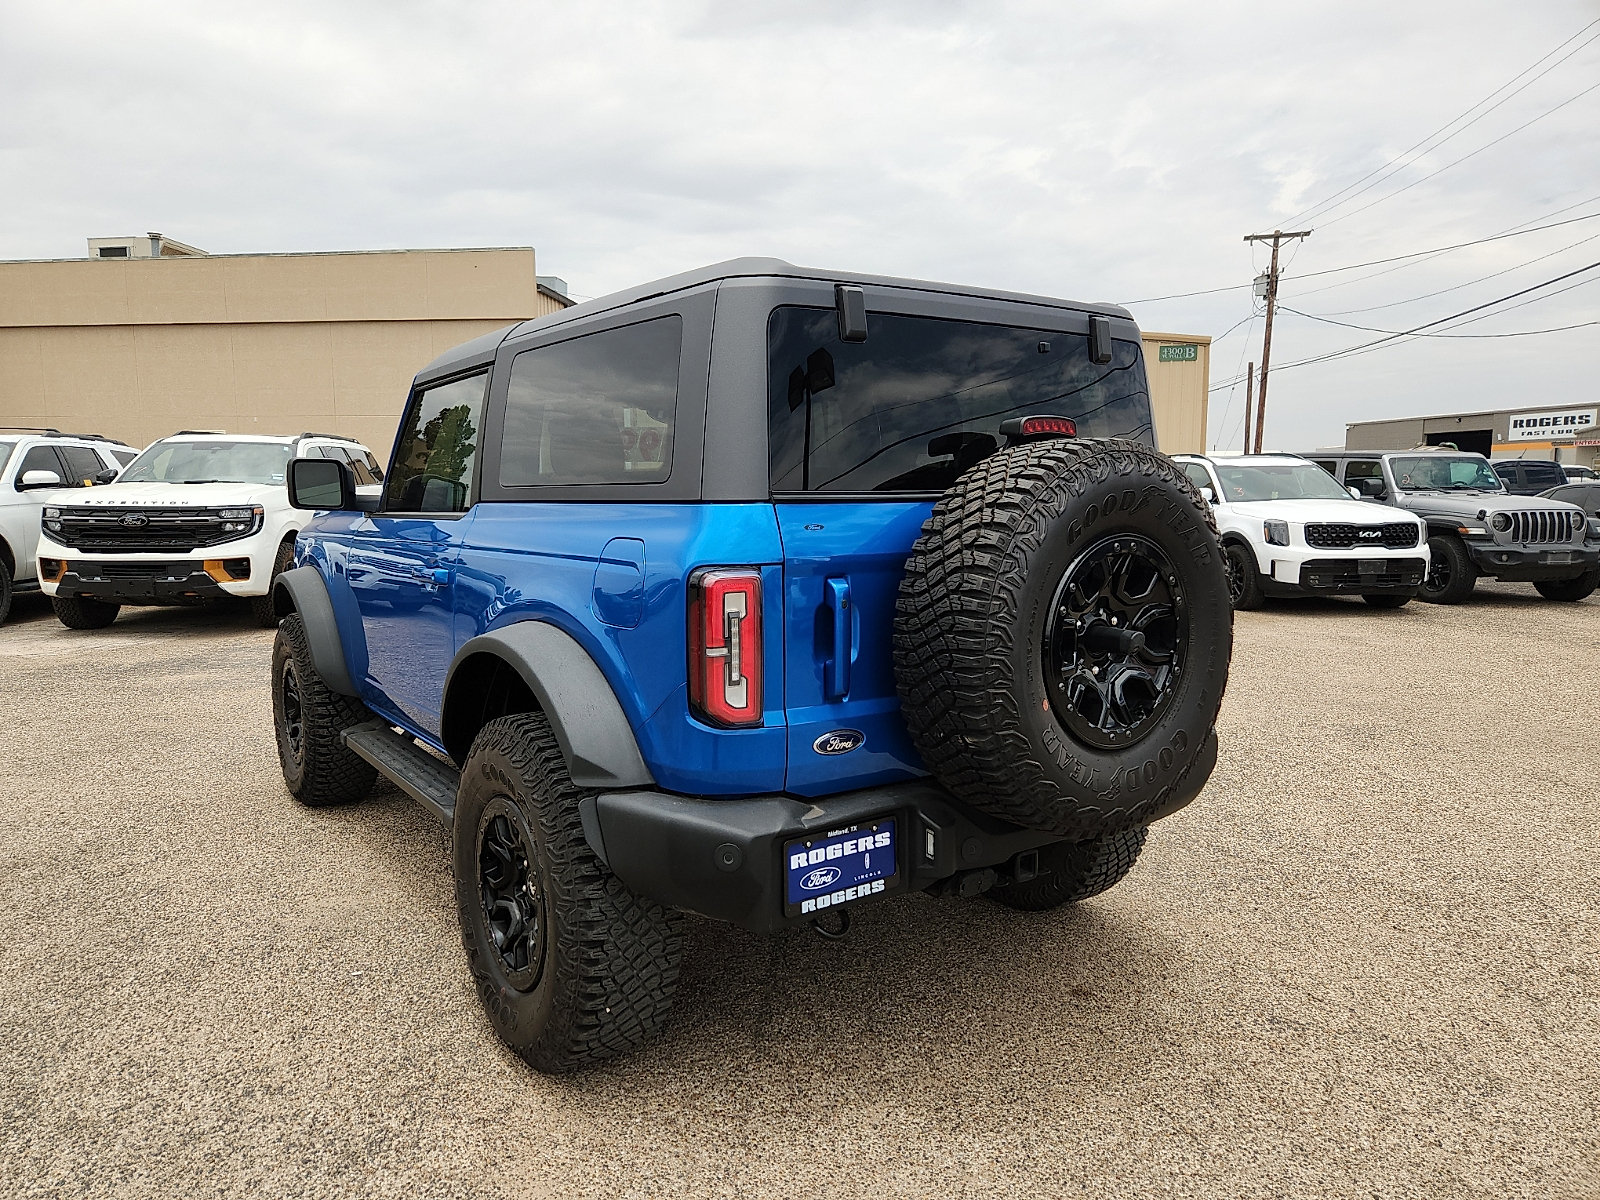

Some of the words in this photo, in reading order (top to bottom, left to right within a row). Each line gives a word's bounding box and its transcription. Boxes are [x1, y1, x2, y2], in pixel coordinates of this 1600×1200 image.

[1185, 347, 1195, 358] B
[1513, 414, 1591, 429] ROGERS
[827, 735, 854, 751] Ford
[790, 832, 891, 870] ROGERS
[808, 870, 833, 888] Ford
[854, 870, 881, 881] LINCOLN
[801, 879, 885, 914] ROGERS
